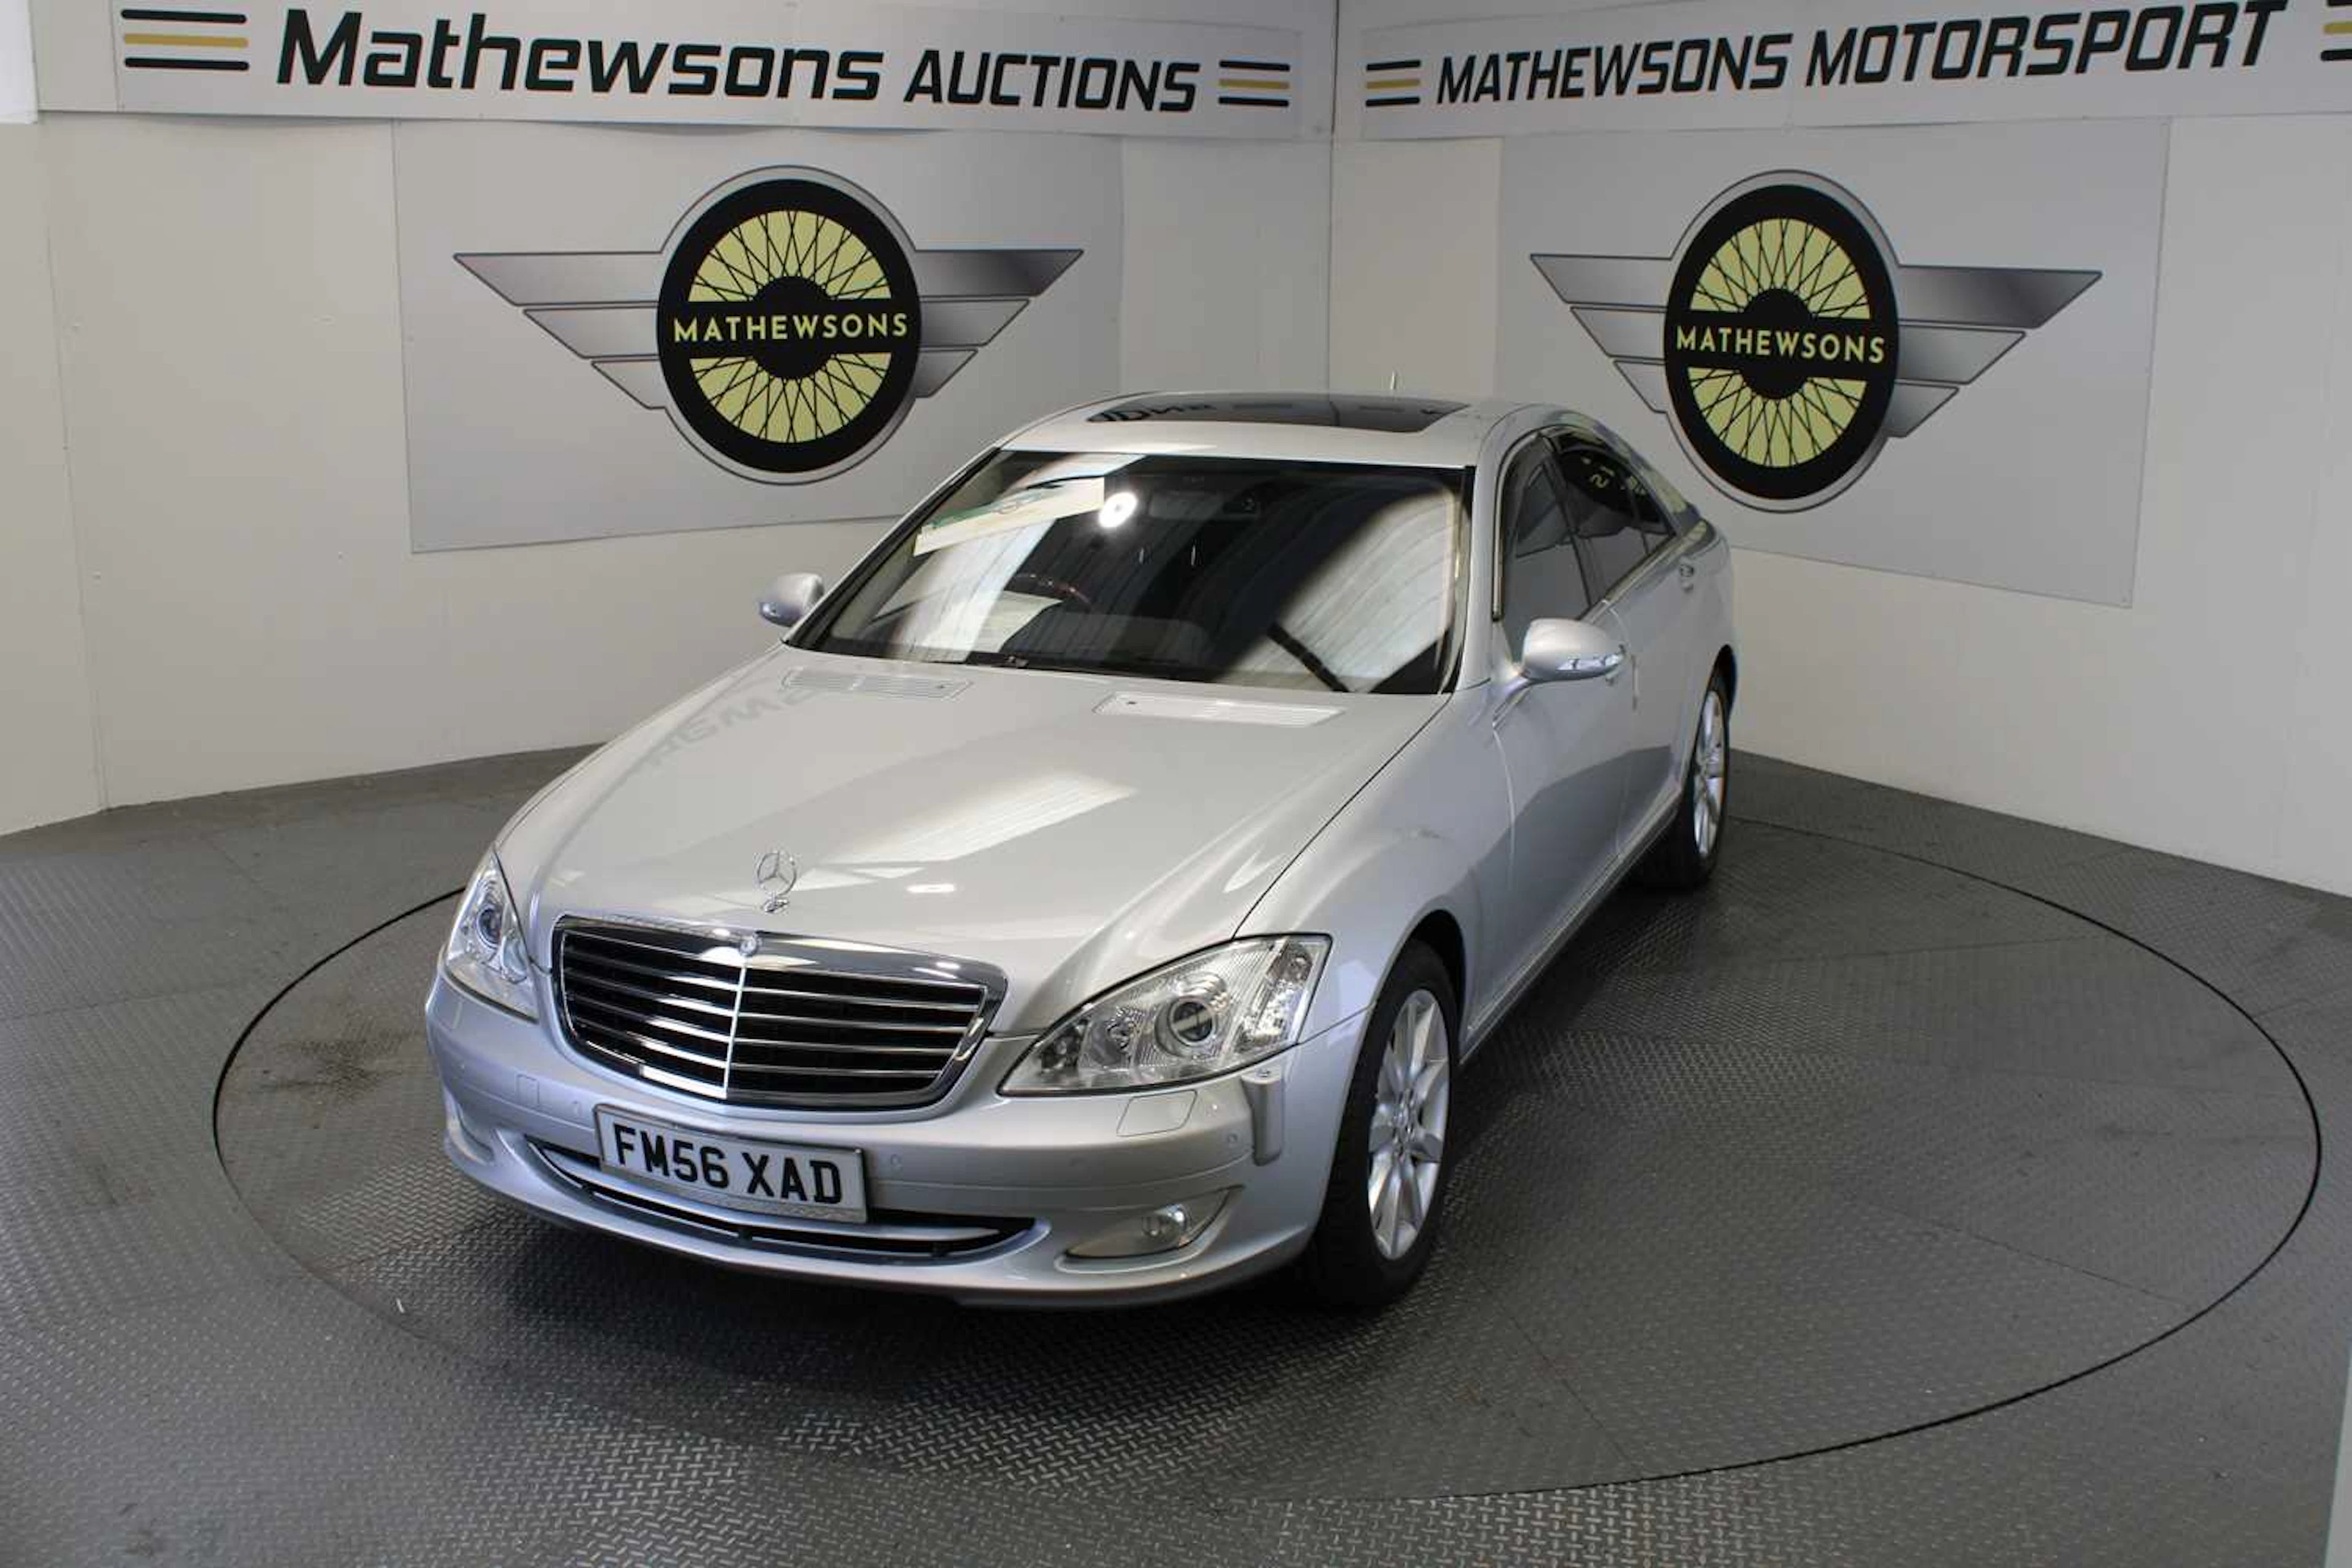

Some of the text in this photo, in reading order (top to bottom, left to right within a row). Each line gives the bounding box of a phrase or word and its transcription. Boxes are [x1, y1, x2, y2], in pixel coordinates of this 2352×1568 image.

[277, 9, 1201, 112] Mathewsons AUCTIONS
[1437, 0, 2288, 104] MATHEWSONS MOTORSPORT
[674, 312, 908, 343] MATHEWSONS
[1676, 325, 1885, 364] MATHEWSONS
[613, 1123, 729, 1189] FM56
[742, 1152, 842, 1205] XAD
